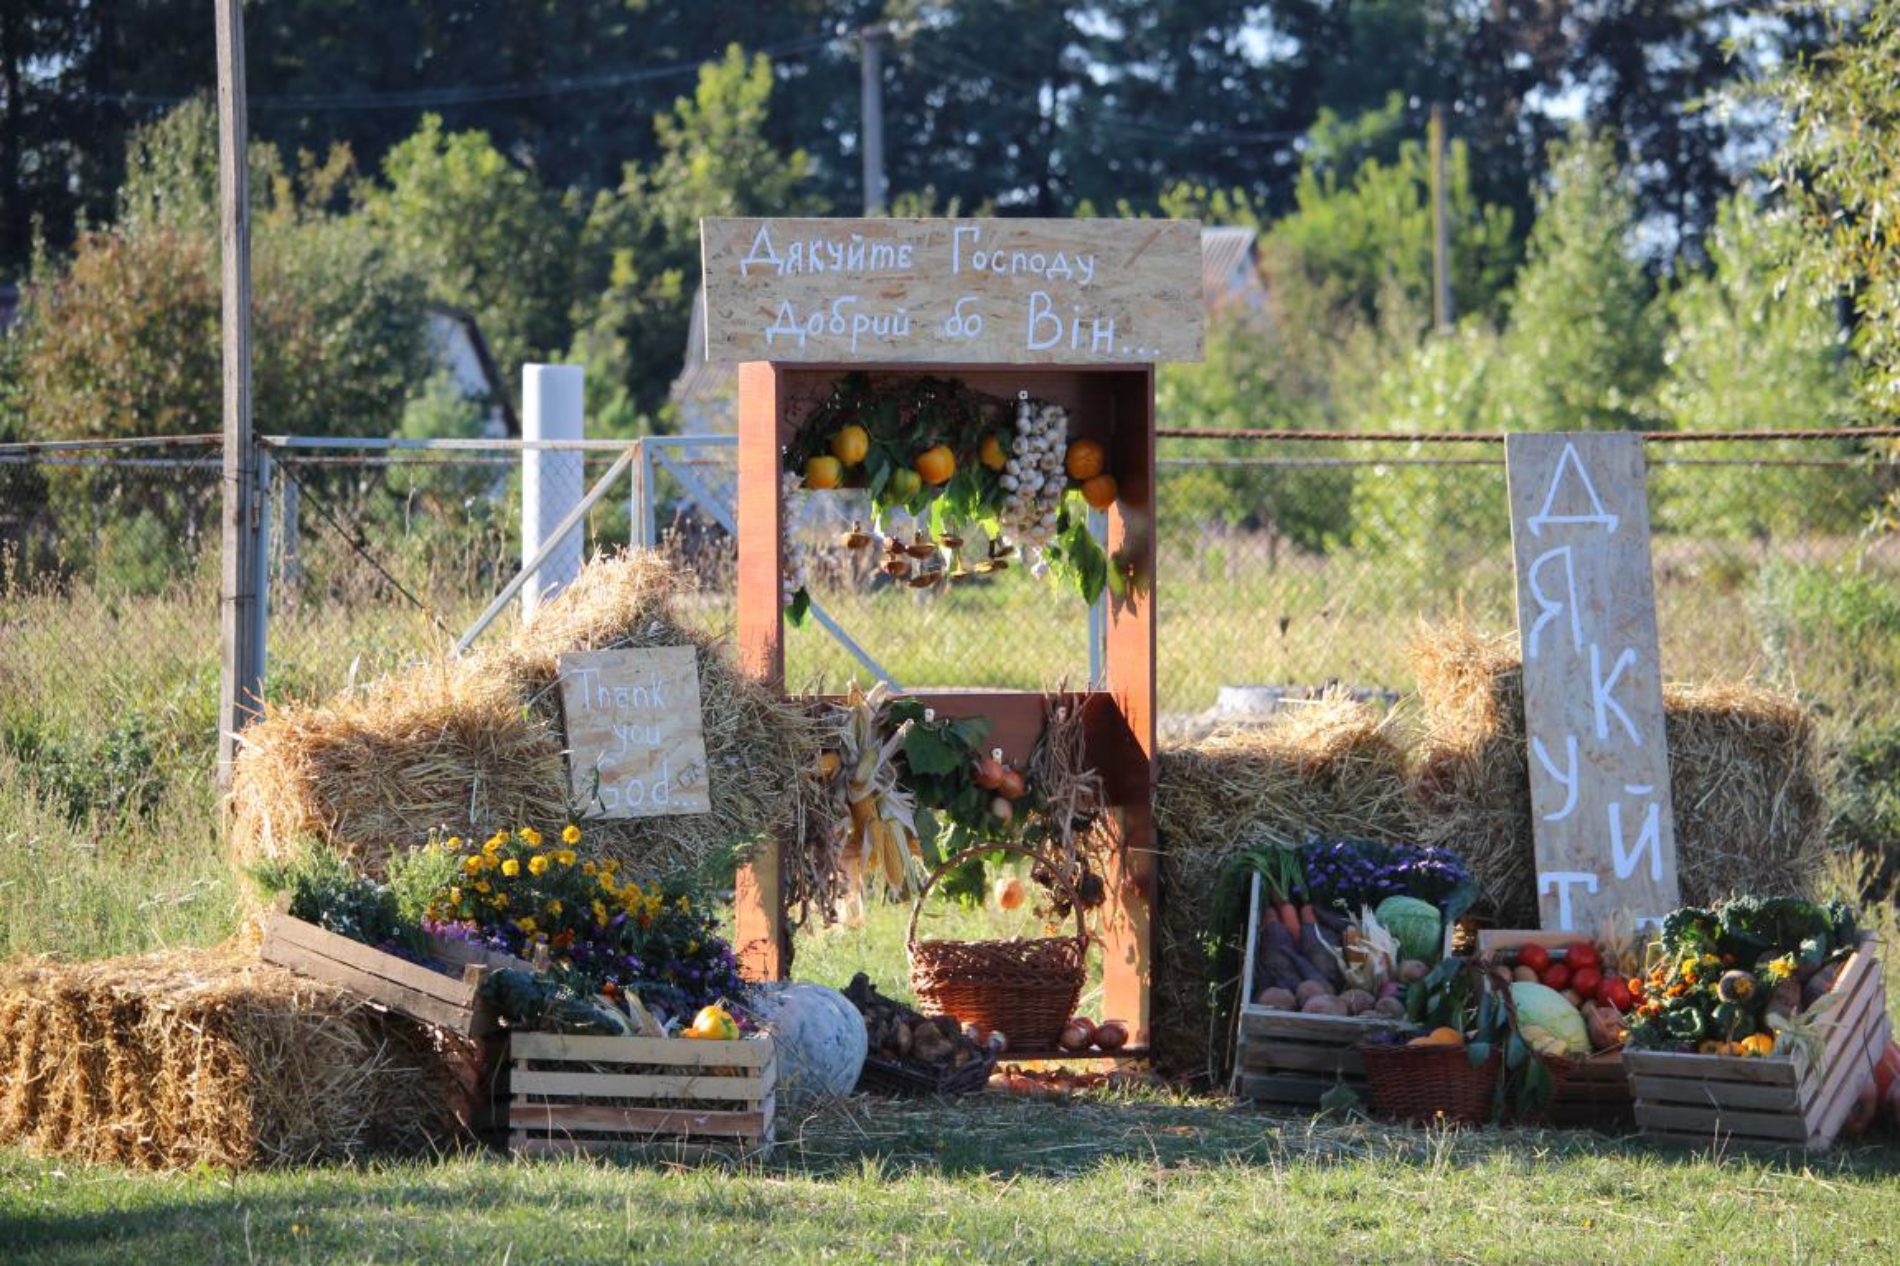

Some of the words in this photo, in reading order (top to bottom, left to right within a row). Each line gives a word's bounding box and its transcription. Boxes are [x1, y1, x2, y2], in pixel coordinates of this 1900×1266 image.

[740, 225, 914, 278] Дякуйте
[952, 226, 1094, 284] Господу
[766, 297, 910, 354] Добрий
[945, 297, 983, 338] бо
[572, 668, 666, 712] Thank
[1527, 442, 1665, 931] ДЯКУЙТ
[612, 723, 661, 755] you
